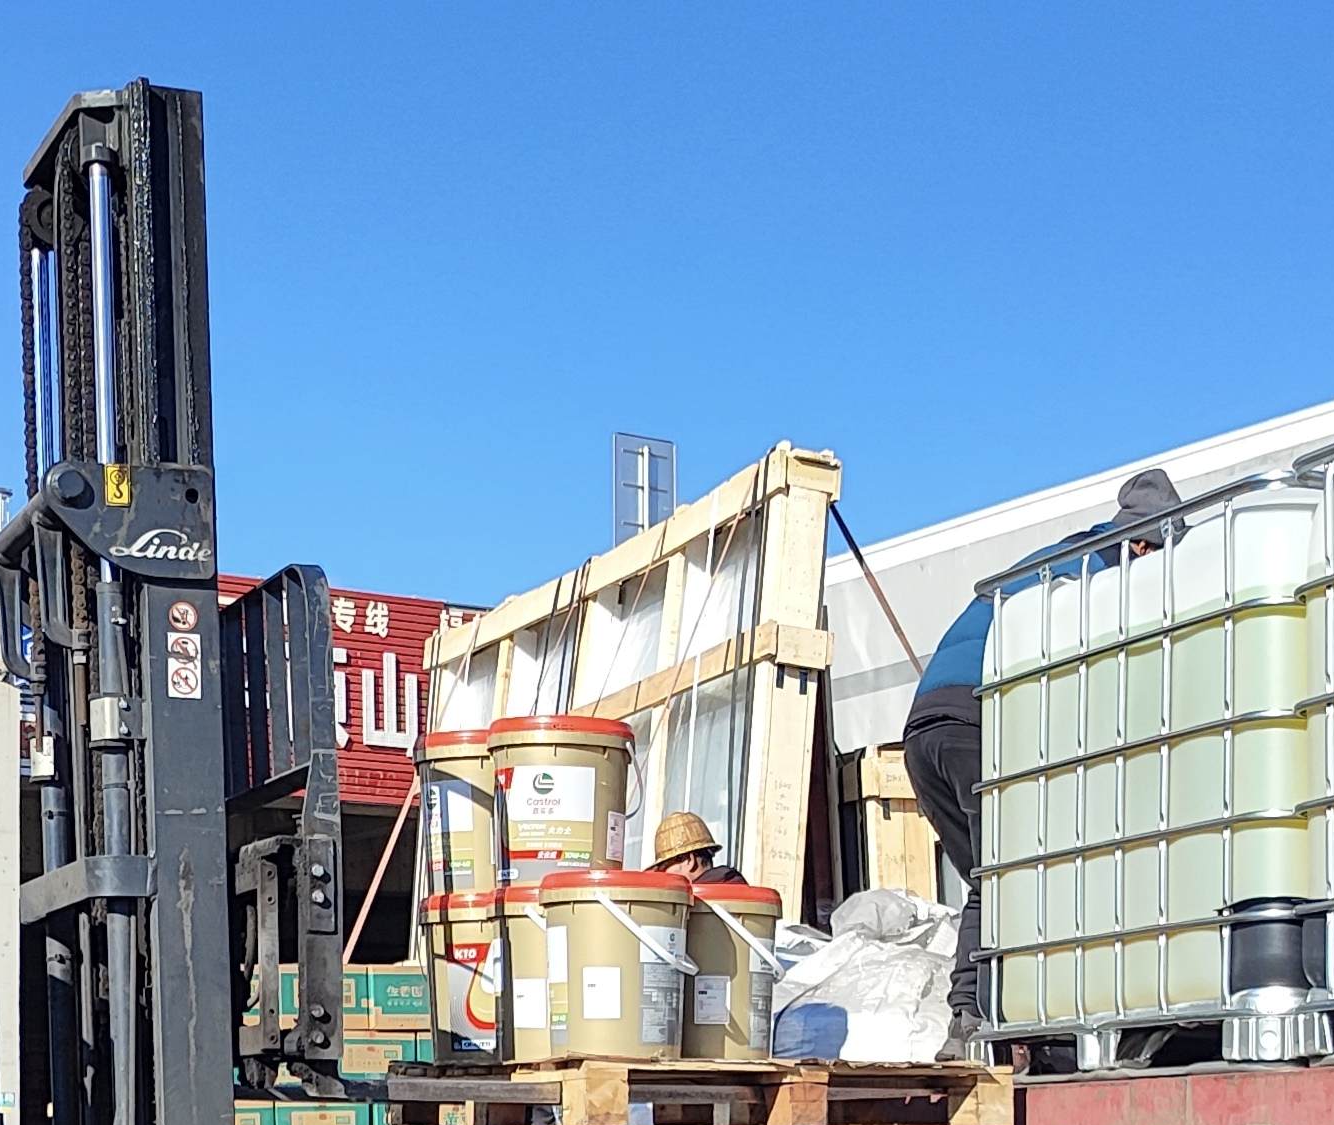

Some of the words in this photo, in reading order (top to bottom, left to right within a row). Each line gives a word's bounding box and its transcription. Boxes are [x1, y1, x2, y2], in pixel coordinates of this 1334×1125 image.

[109, 528, 212, 562] Linde
[332, 597, 389, 638] 专线
[333, 647, 419, 757] 山
[526, 797, 561, 807] Castrol
